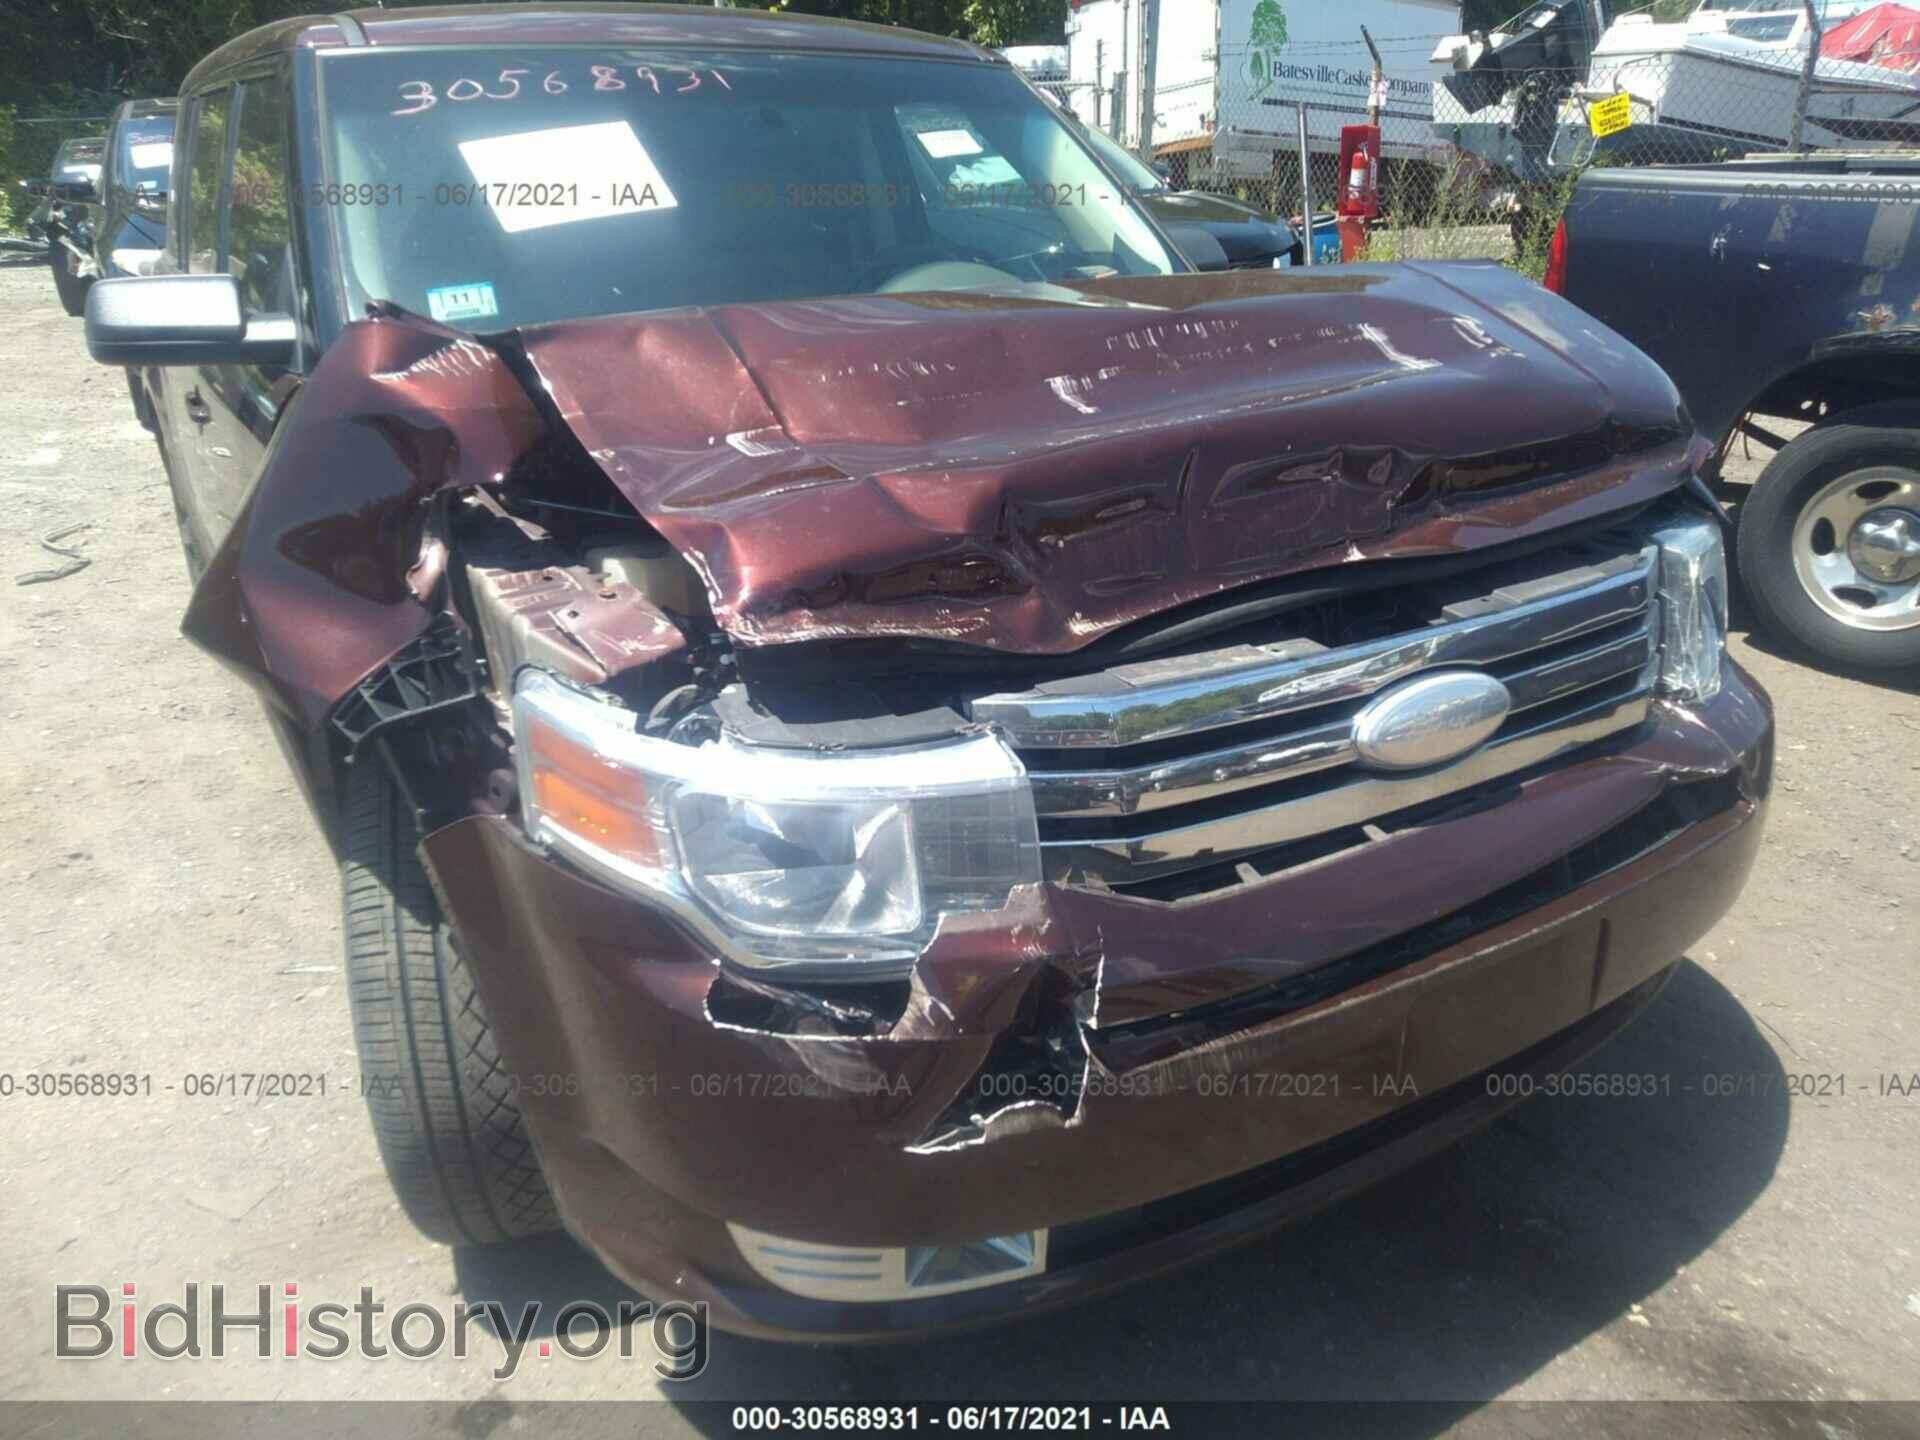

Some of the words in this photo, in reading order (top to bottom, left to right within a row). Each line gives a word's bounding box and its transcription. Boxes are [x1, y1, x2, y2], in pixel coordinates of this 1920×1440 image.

[390, 64, 733, 116] 30568931
[1273, 61, 1335, 83] Batesville
[1335, 68, 1372, 87] Caske
